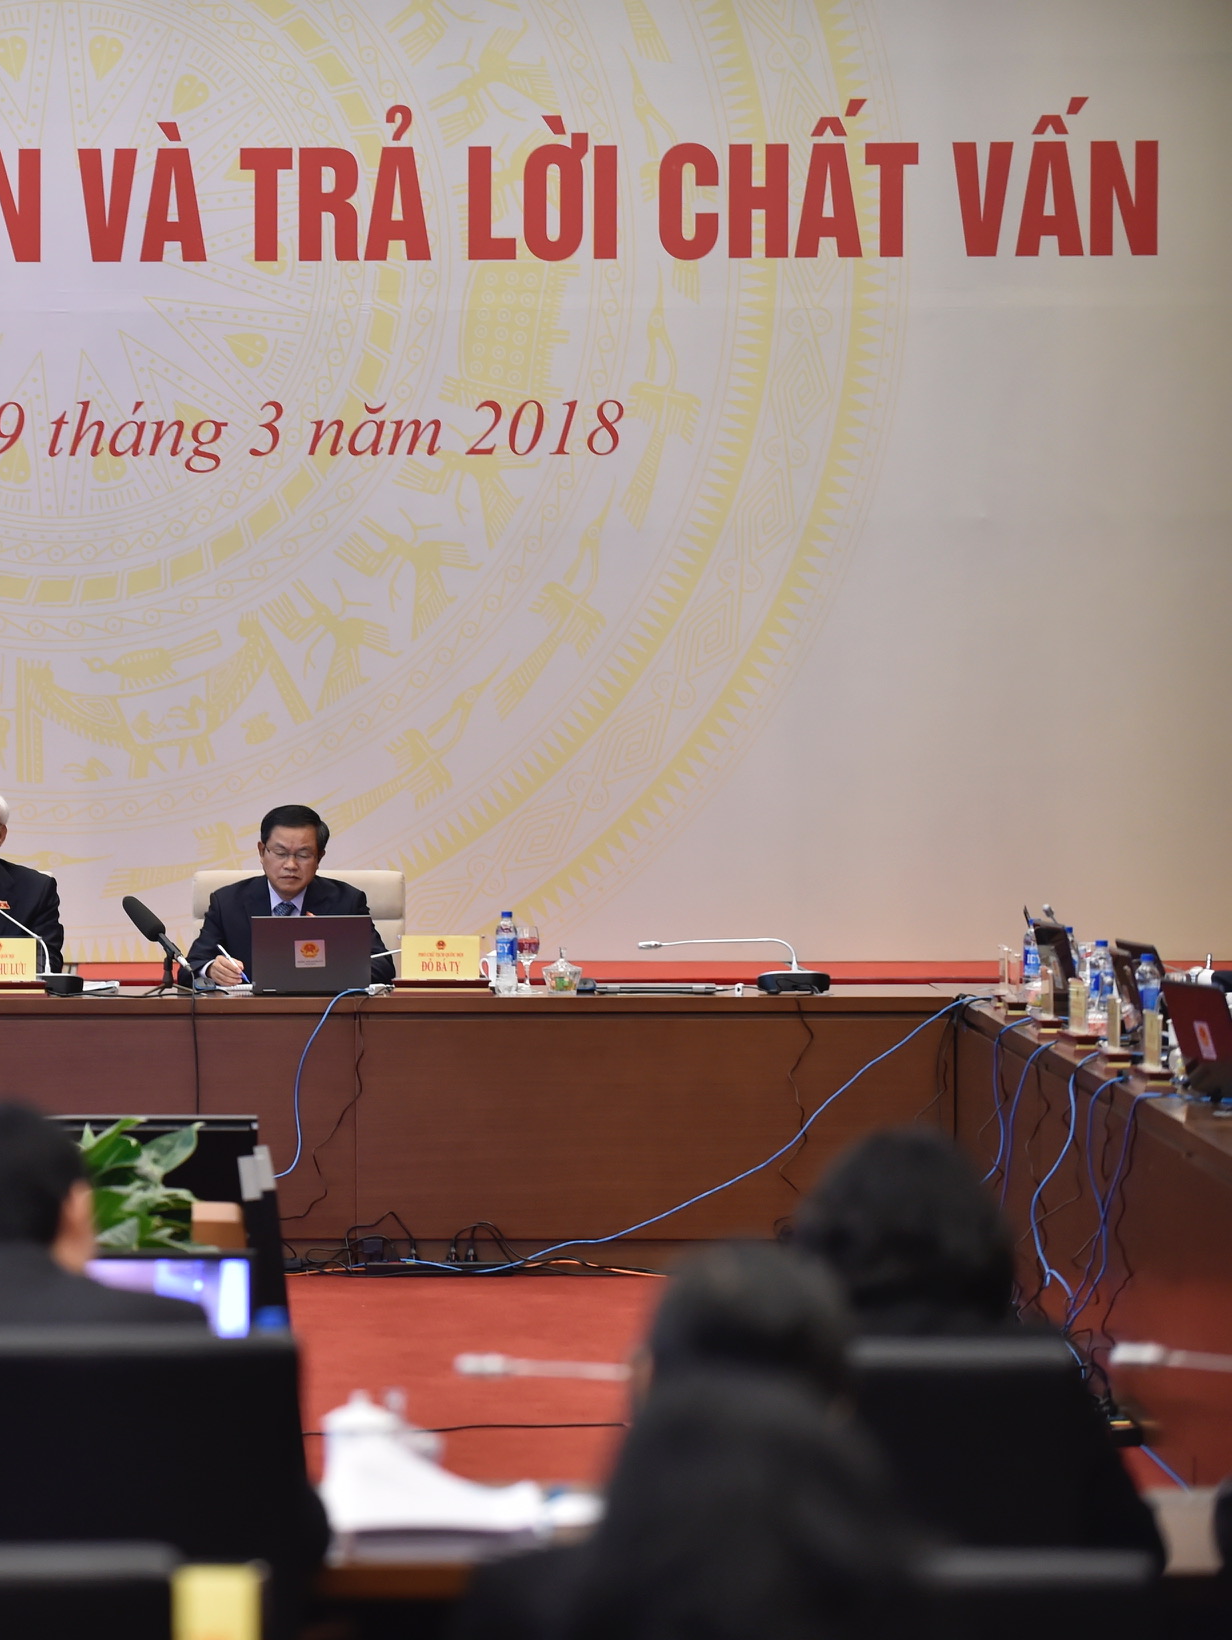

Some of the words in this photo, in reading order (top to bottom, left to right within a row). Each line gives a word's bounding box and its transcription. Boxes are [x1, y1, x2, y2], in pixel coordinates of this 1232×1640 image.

[78, 121, 207, 262] VÀ
[240, 104, 431, 262] TRẢ
[468, 115, 618, 262] LỜI
[659, 98, 919, 261] CHẤT
[953, 97, 1158, 257] VẤN
[48, 400, 229, 474] tháng
[249, 400, 284, 457] 3
[308, 401, 442, 457] năm
[466, 399, 625, 456] 2018
[436, 957, 447, 972] BÁ
[496, 943, 510, 953] CY
